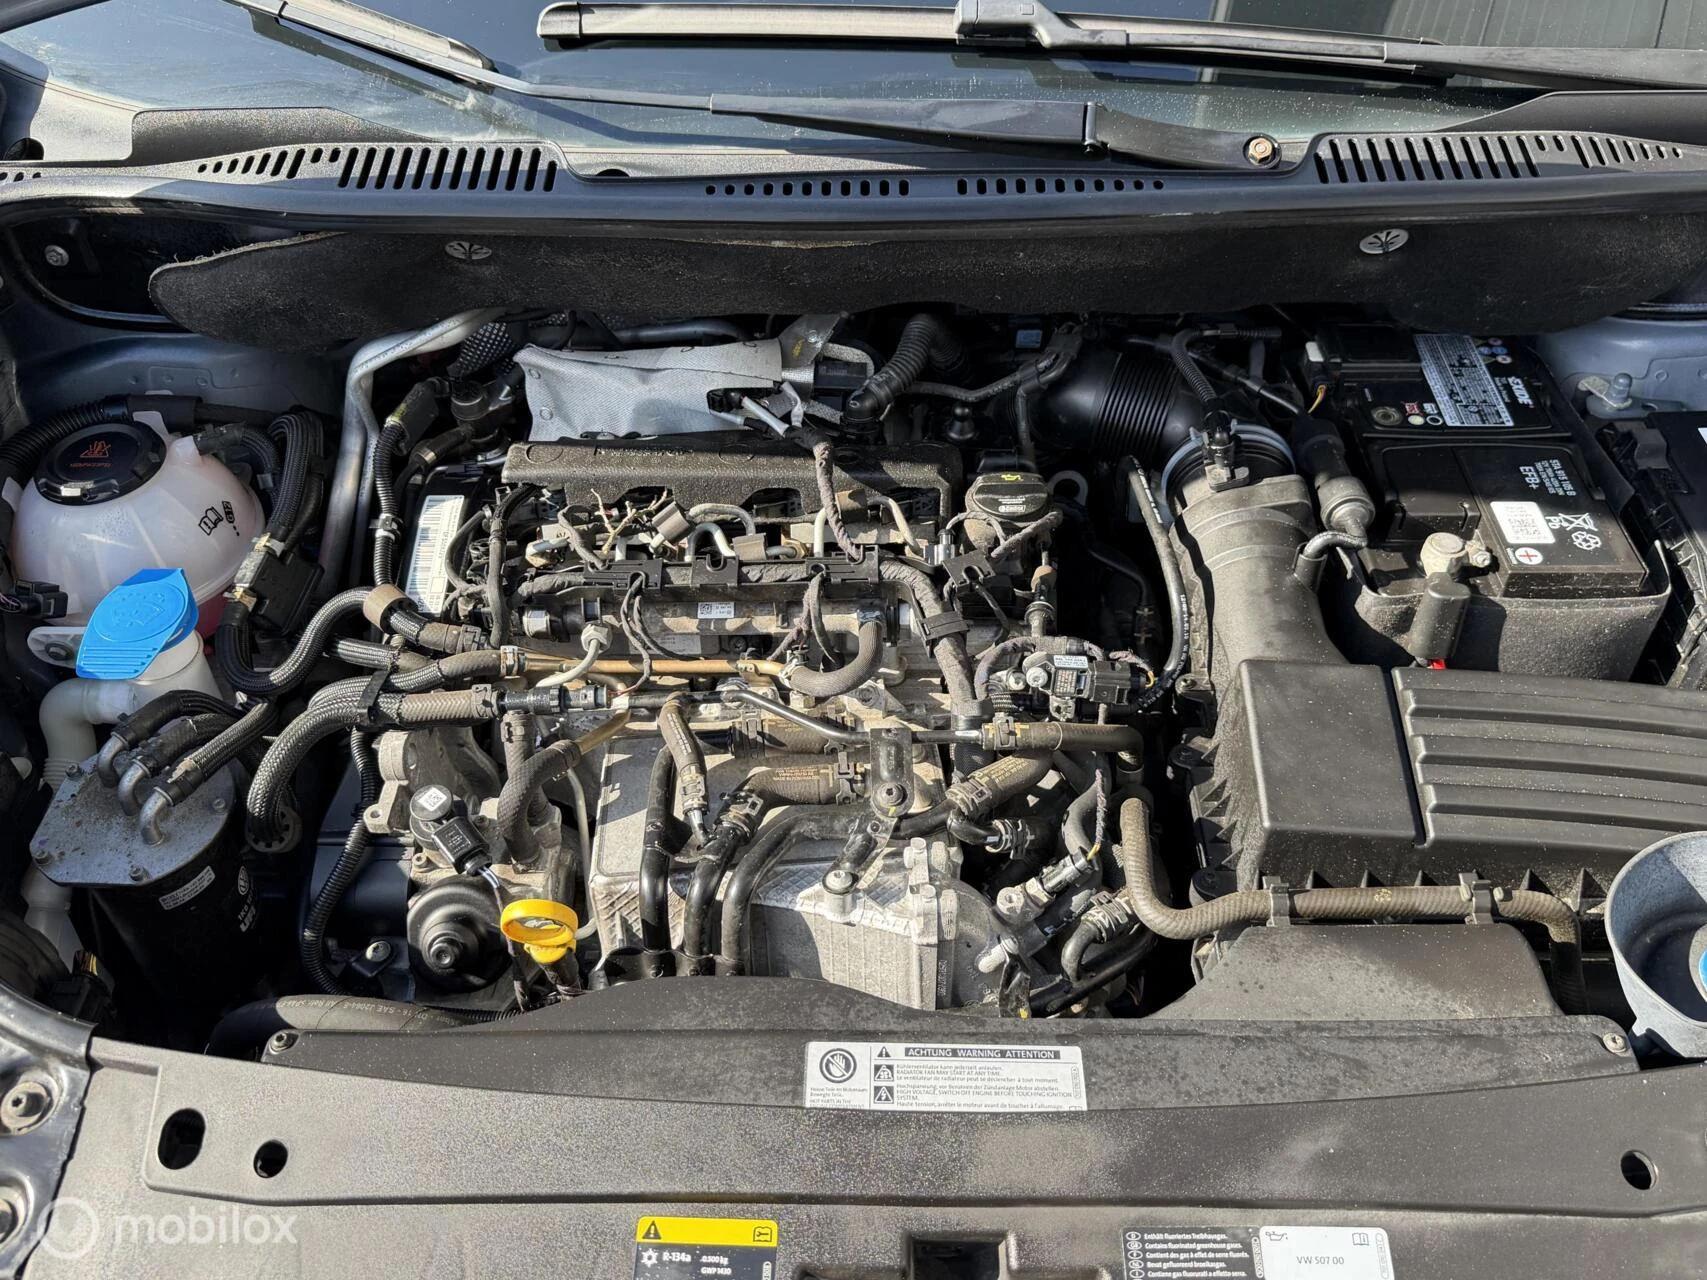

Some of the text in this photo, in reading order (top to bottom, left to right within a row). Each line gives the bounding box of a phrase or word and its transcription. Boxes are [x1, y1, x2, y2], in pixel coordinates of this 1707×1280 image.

[1519, 466, 1541, 490] EFB+
[908, 1048, 1055, 1059] ACHTUNG WARNING ATTENTION
[1296, 1256, 1345, 1264] VW 507 00
